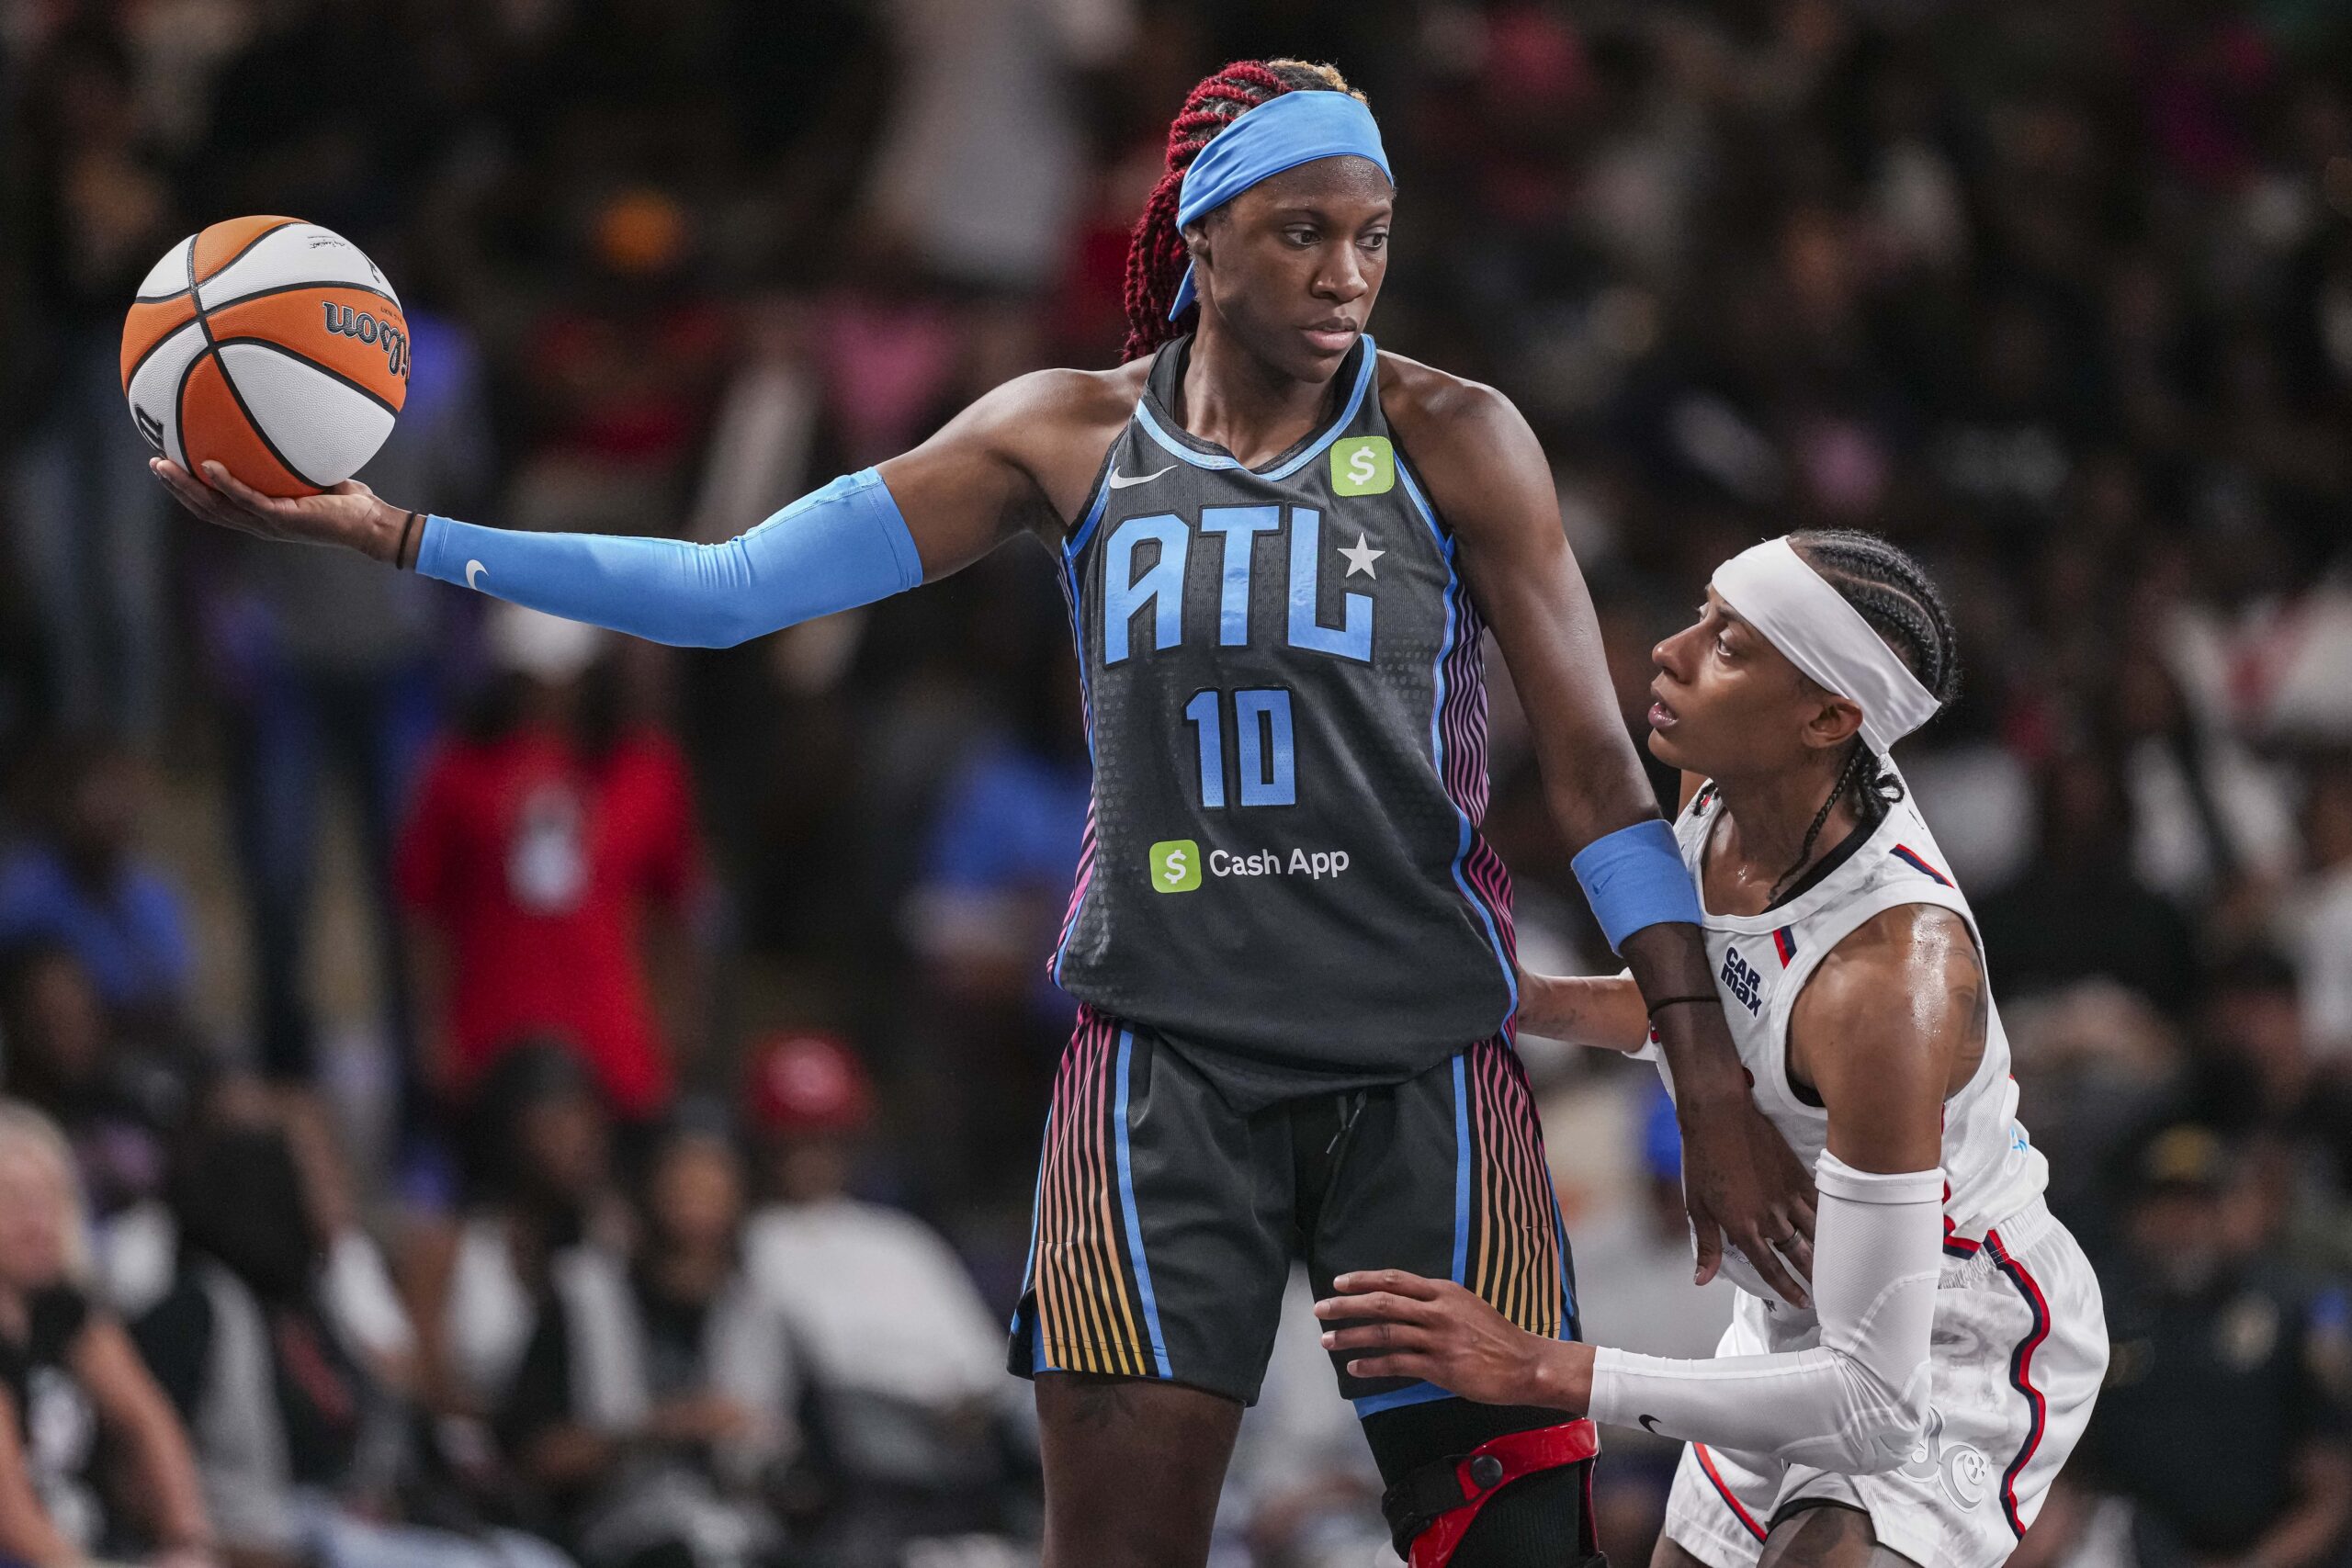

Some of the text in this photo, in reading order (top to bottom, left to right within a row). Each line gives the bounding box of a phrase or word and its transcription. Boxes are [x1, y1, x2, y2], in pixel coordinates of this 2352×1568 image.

[322, 300, 410, 378] ilson
[1104, 504, 1374, 666] ATL
[1185, 689, 1296, 807] 10
[1209, 849, 1282, 877] Cash
[1287, 848, 1350, 880] App
[1721, 963, 1762, 1018] max
[1725, 947, 1761, 992] CAR
